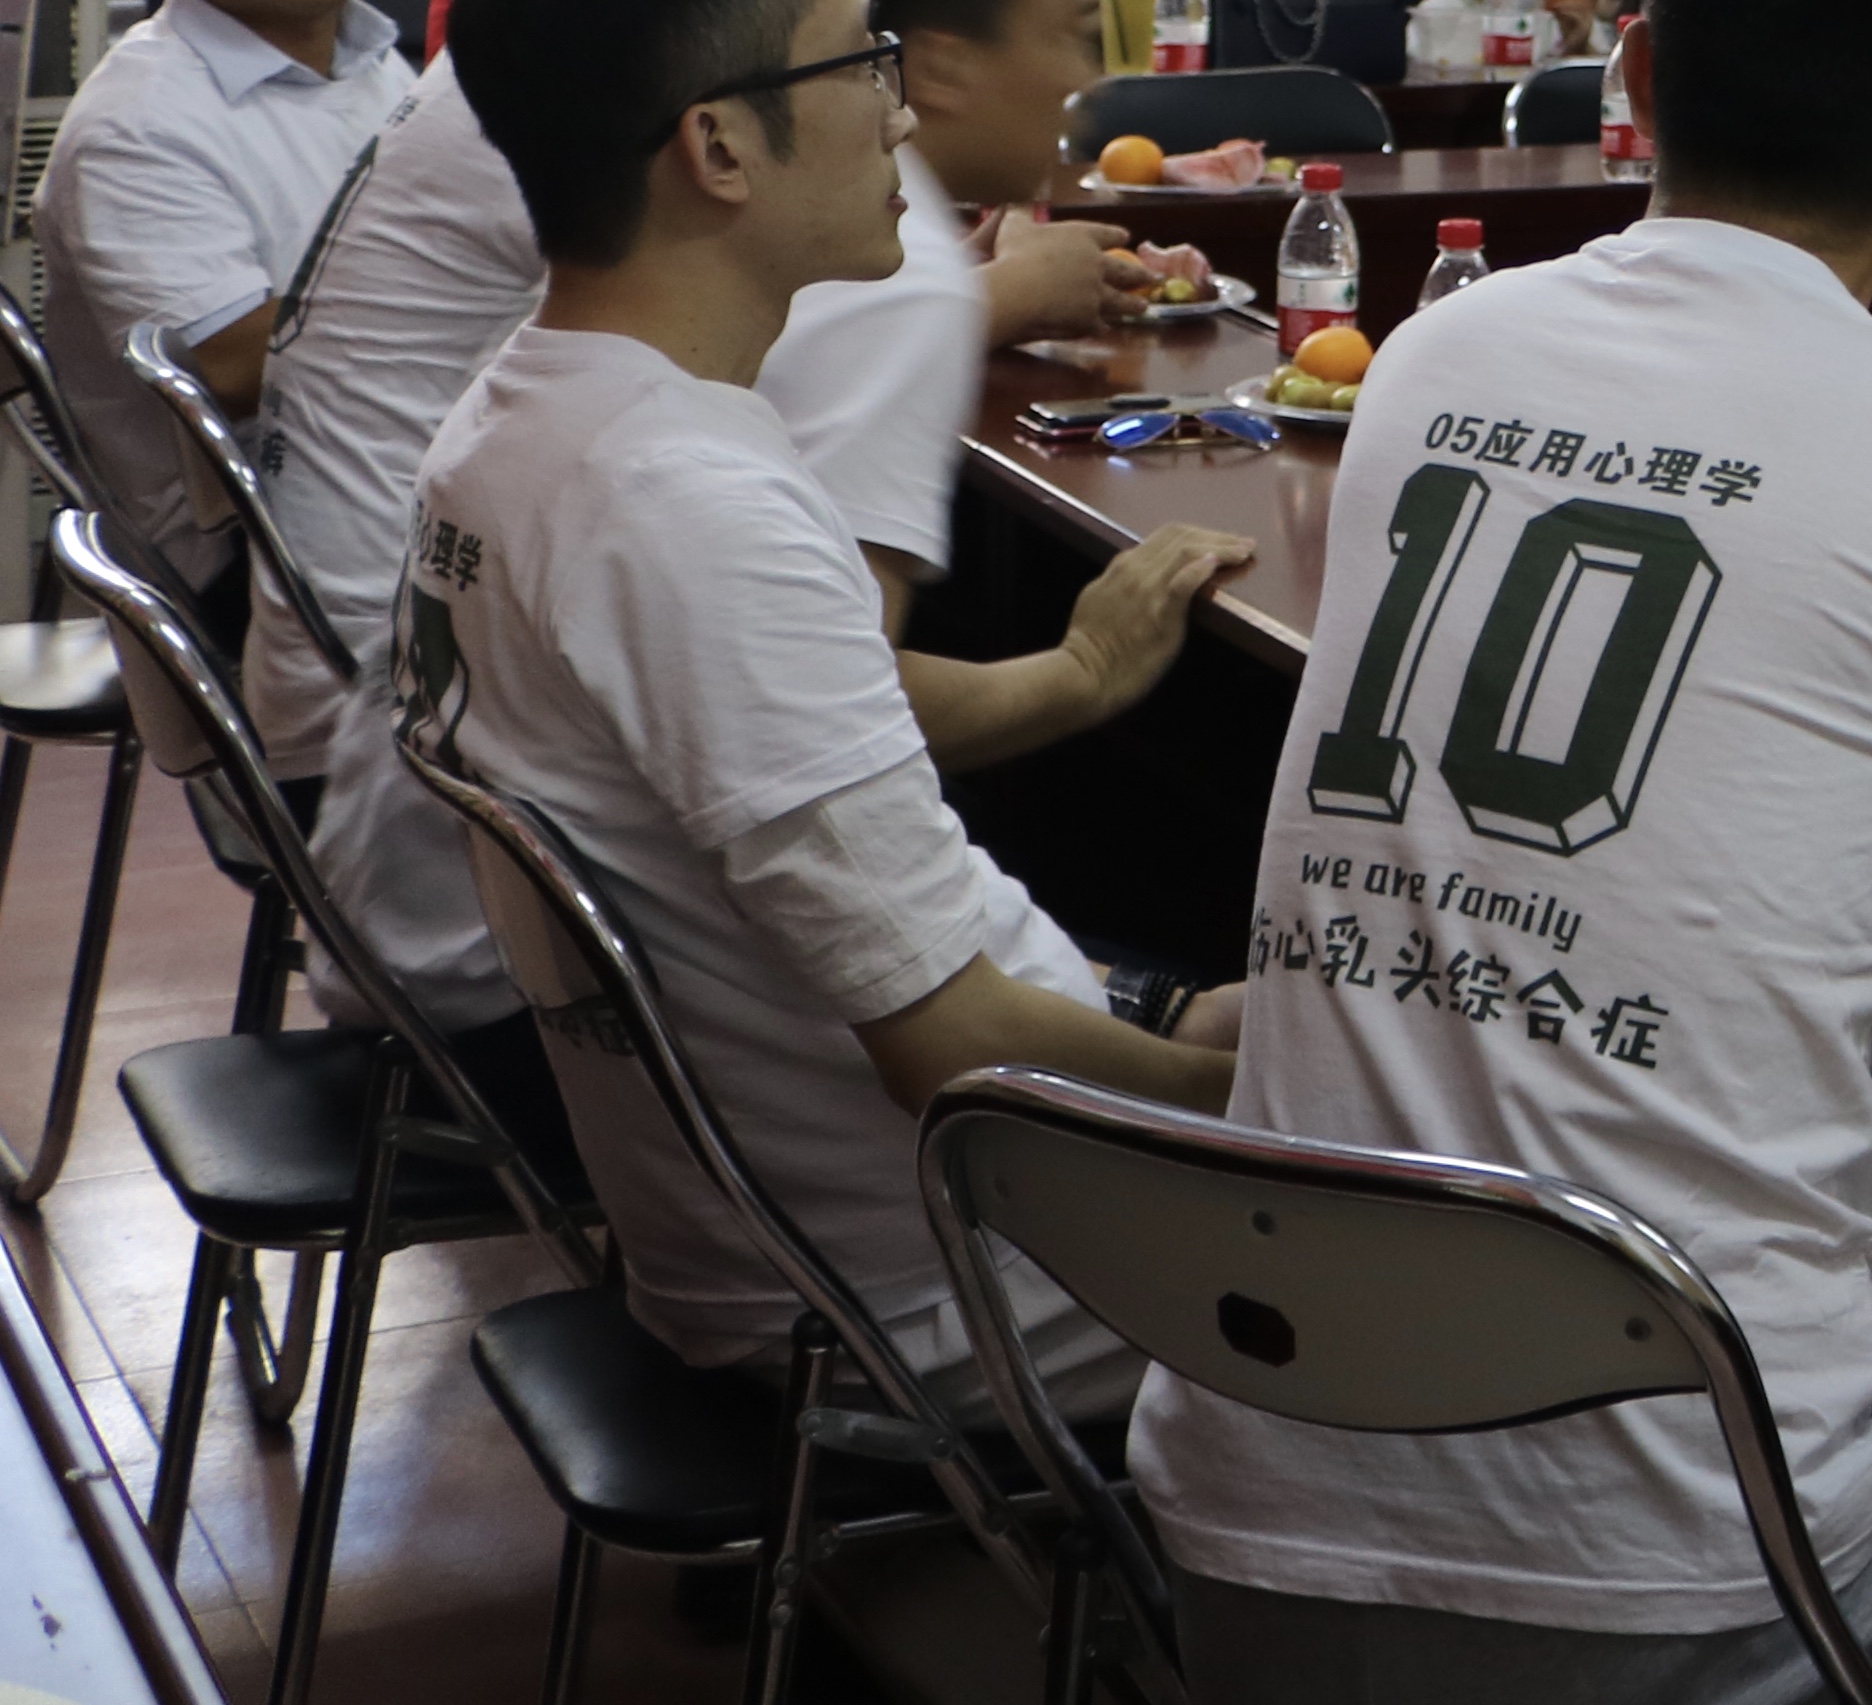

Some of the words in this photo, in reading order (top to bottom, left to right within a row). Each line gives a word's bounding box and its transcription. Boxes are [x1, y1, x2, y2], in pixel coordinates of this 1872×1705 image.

[1424, 412, 1763, 508] 05应用心理学
[1306, 462, 1723, 858] 10
[1301, 853, 1351, 889] we
[1364, 863, 1427, 904] are
[1437, 872, 1583, 954] family
